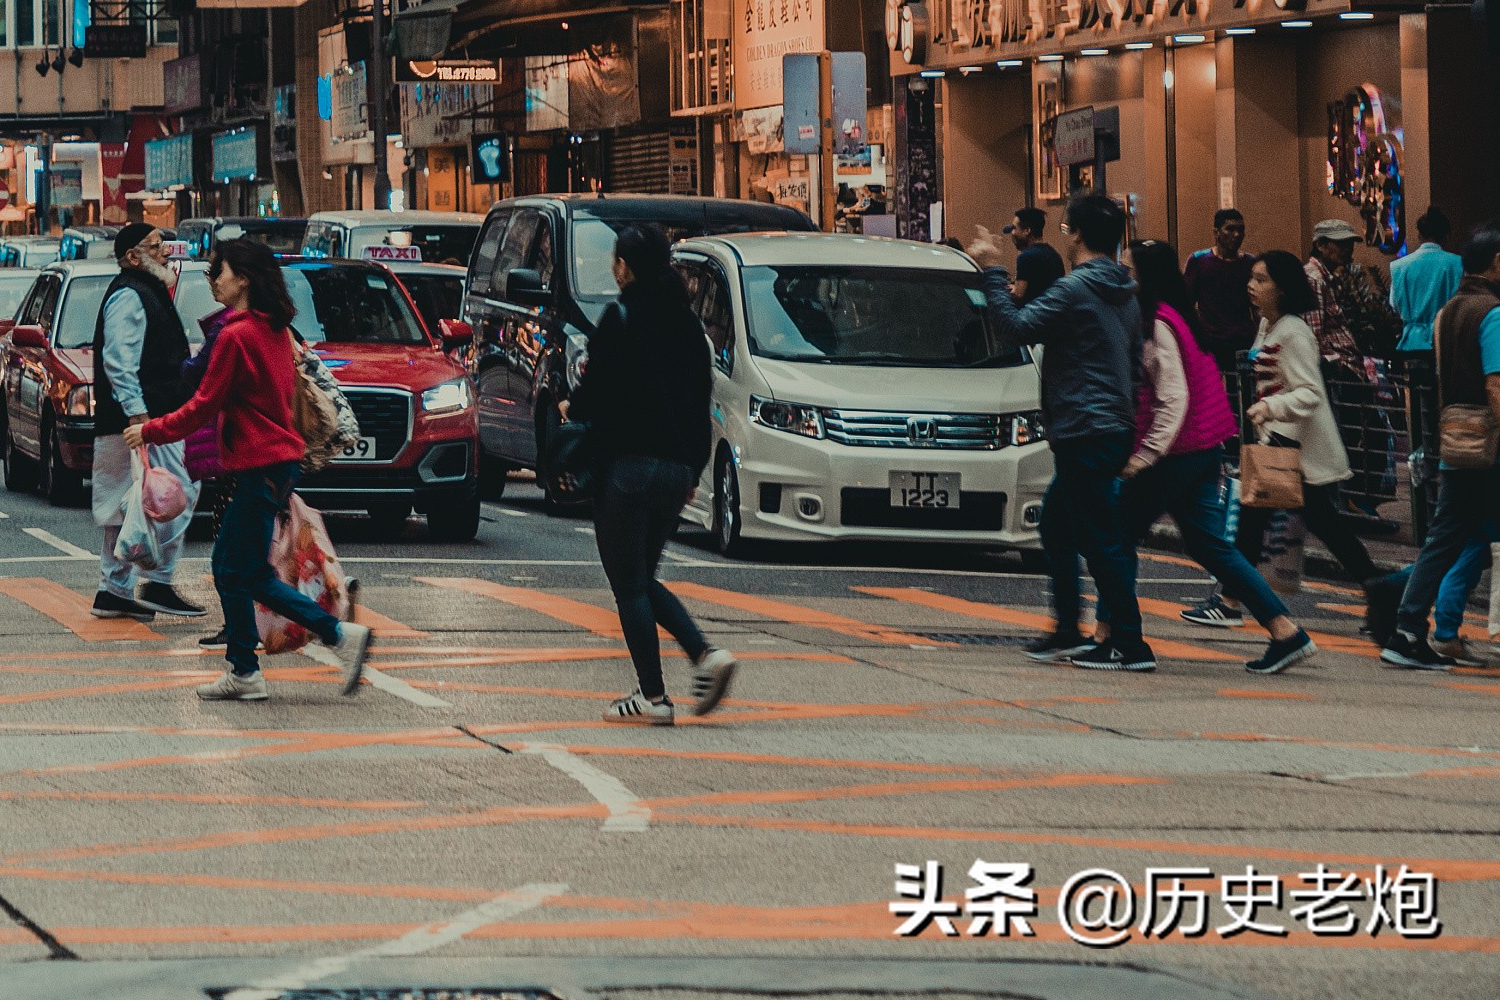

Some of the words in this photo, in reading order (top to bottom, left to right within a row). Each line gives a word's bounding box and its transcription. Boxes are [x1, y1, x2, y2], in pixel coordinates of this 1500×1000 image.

[367, 247, 418, 259] TAXI
[911, 472, 938, 490] TT
[900, 489, 949, 507] 1223
